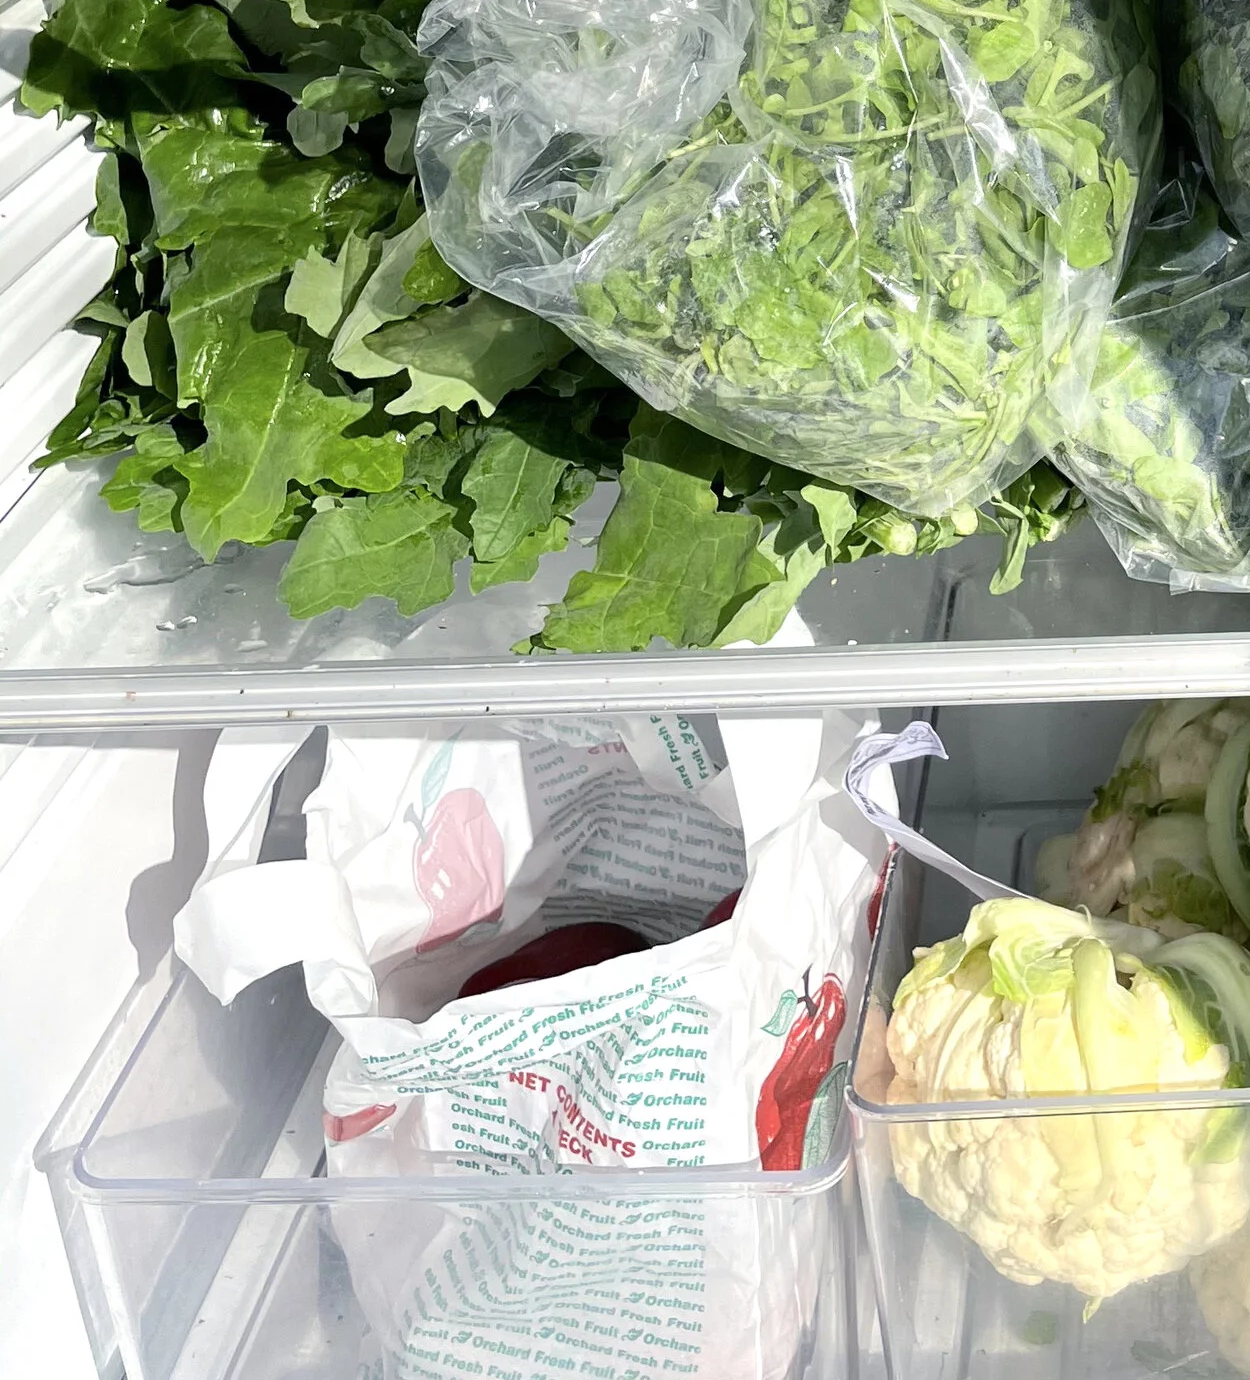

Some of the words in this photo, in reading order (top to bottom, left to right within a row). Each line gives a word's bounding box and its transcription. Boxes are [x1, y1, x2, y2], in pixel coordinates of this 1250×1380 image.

[659, 726, 680, 762] Fresh
[692, 748, 709, 779] Fruit
[509, 1072, 550, 1093] NET
[452, 1103, 505, 1124] Orchard
[509, 1120, 540, 1141] Fresh
[556, 1084, 636, 1158] CONTENTS
[619, 1113, 659, 1130] Fresh
[668, 1119, 705, 1130] Fruit
[559, 1133, 593, 1164] ECK
[413, 1326, 449, 1340] Fruit
[473, 1336, 530, 1359] Orchard
[534, 1351, 575, 1371] Fresh
[581, 1363, 616, 1380] Fruit
